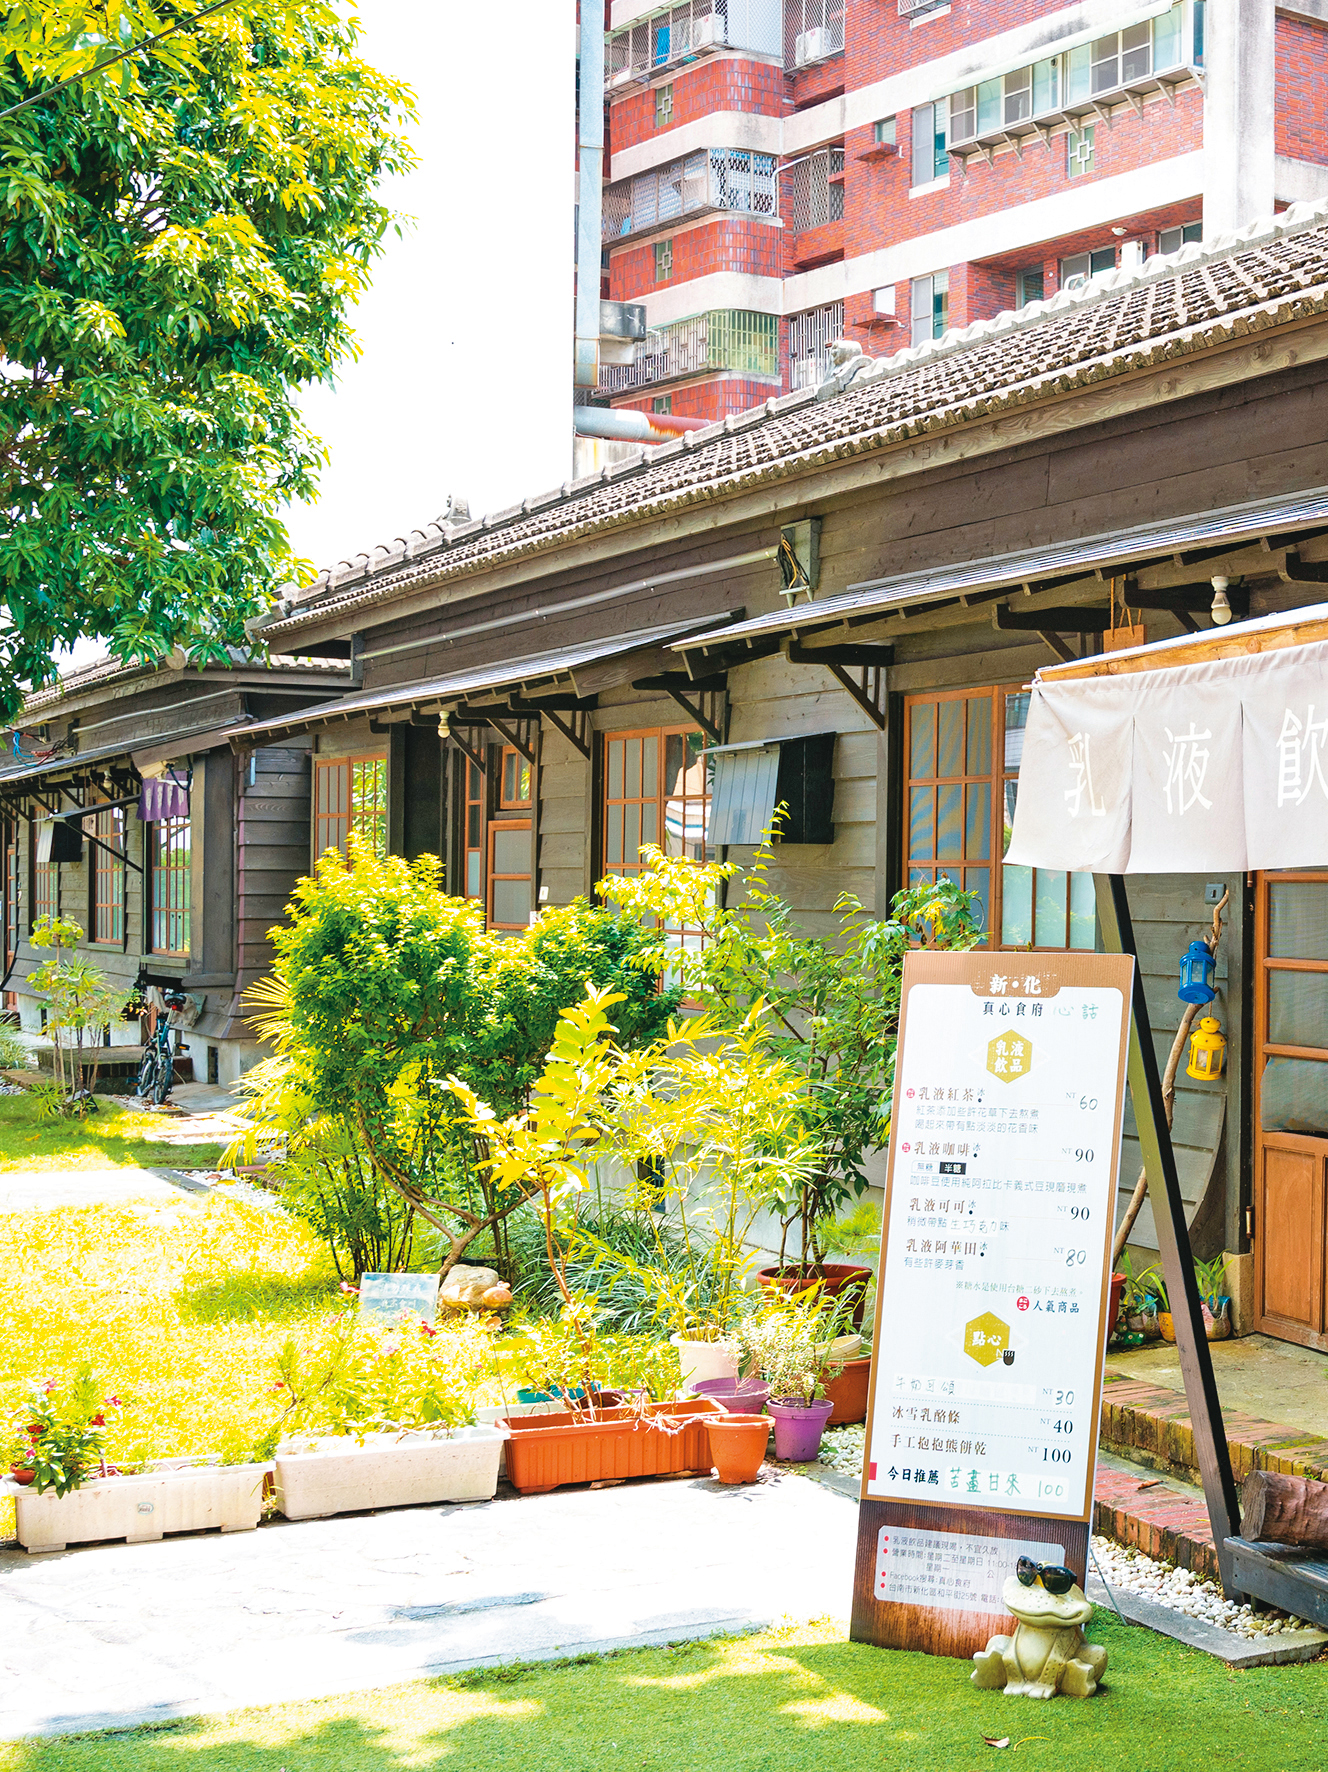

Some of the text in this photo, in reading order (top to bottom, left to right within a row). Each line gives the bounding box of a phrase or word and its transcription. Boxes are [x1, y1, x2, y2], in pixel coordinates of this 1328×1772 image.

[983, 1001, 1043, 1017] 真心食府
[996, 1039, 1024, 1057] 乳液
[1079, 1095, 1098, 1111] 60
[1075, 1148, 1095, 1163] 90
[1070, 1206, 1090, 1221] 90
[1065, 1248, 1087, 1267] 80
[1033, 1300, 1080, 1313] 人氣商品
[972, 1331, 1002, 1346] 點心
[1055, 1391, 1075, 1405] 30
[1053, 1420, 1073, 1435] 40
[1042, 1447, 1072, 1464] 100
[887, 1466, 940, 1485] 今日推薦
[1038, 1480, 1064, 1497] 100
